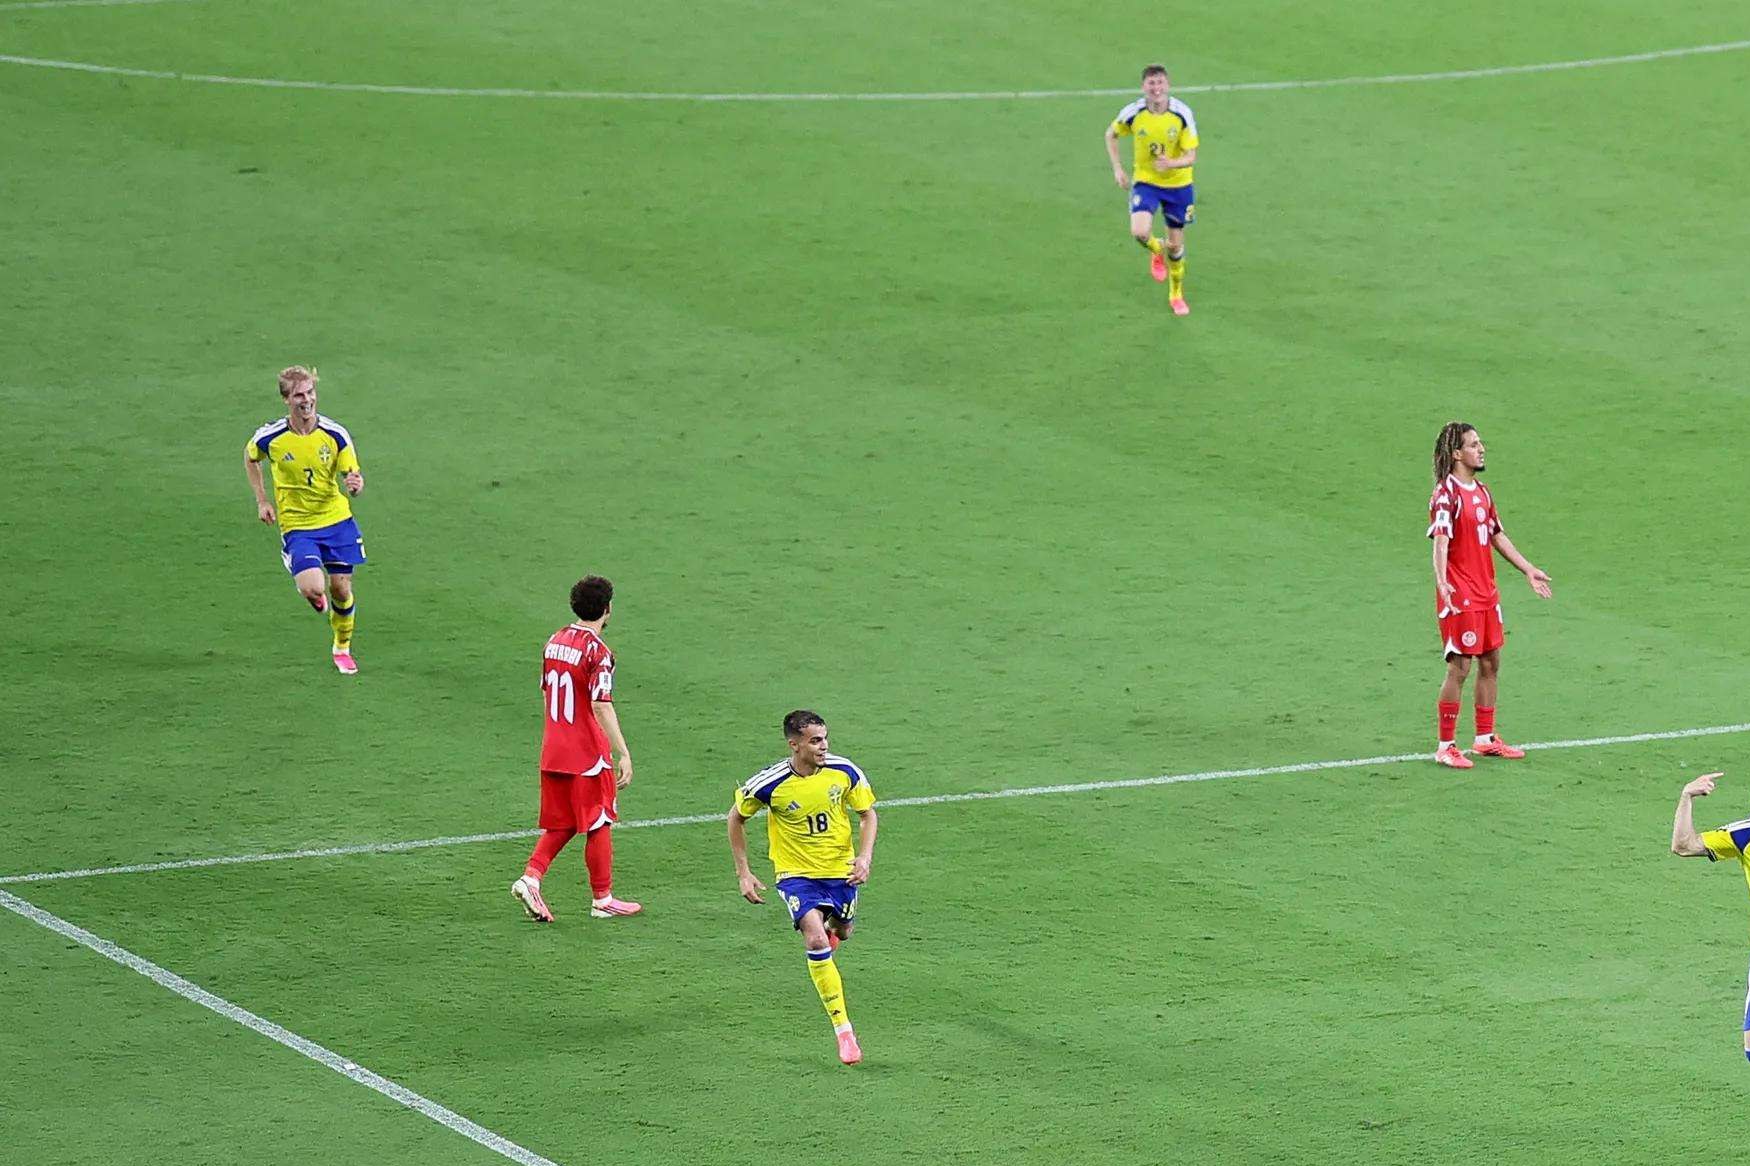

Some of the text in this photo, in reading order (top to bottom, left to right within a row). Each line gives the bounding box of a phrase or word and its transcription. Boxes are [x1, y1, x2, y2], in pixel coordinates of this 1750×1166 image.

[303, 467, 313, 487] 7
[1476, 523, 1489, 546] 10
[547, 669, 574, 725] 11
[806, 812, 828, 836] 18
